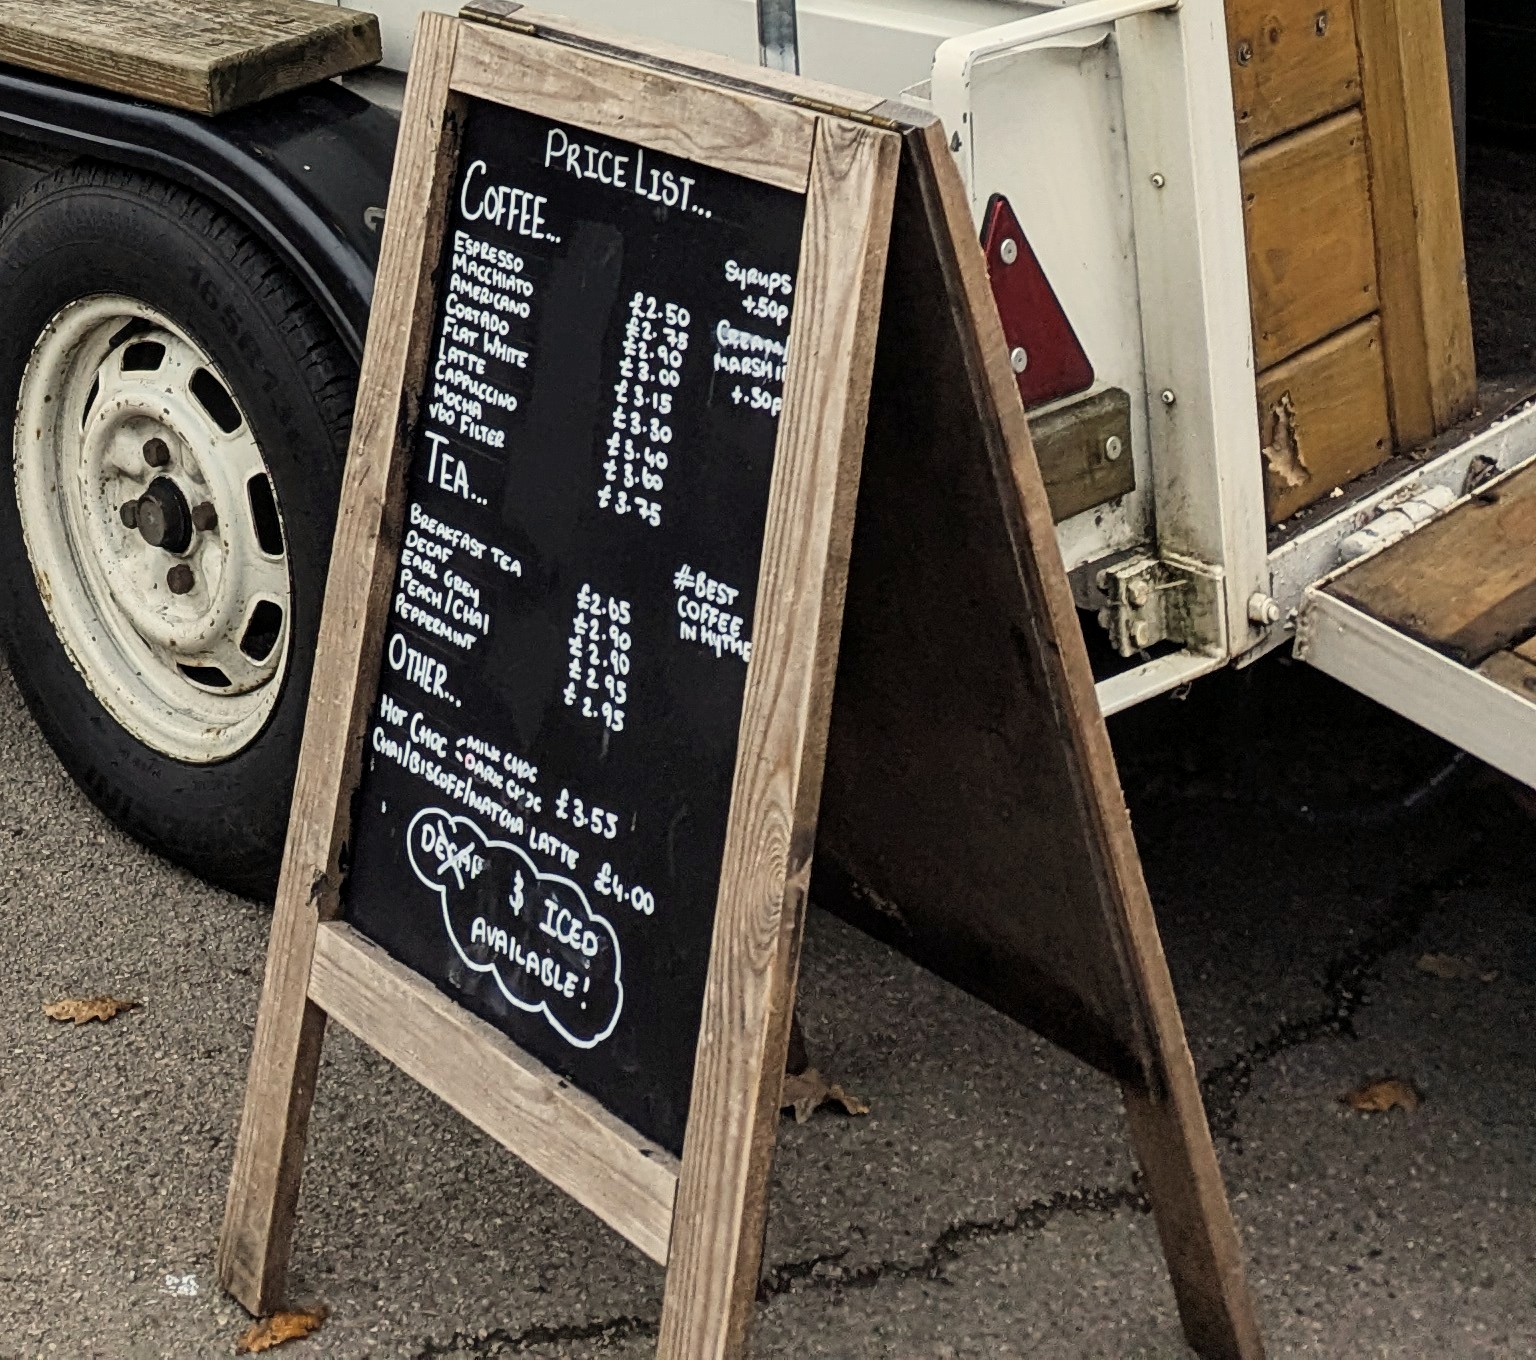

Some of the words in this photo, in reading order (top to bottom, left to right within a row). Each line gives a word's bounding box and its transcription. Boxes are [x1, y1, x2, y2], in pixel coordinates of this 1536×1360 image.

[544, 127, 629, 188] PRICE
[460, 159, 561, 244] COFFEE...
[452, 252, 534, 297] MACCHIATO
[454, 229, 524, 273] ESPRESSO
[445, 292, 510, 336] CORTADO
[450, 272, 531, 319] AMERICANO
[628, 291, 691, 328] £2.50
[438, 336, 487, 375] LATTE
[442, 315, 480, 347] FLAT
[483, 331, 529, 368] WHITE
[433, 382, 482, 420] MOCHA
[434, 359, 518, 412] CAPPUCCINO
[459, 414, 505, 448] FILTER
[424, 430, 488, 506] TEA...
[405, 529, 454, 563] DECAF
[410, 502, 488, 560] BREAKFAST
[490, 546, 522, 578] TEA
[400, 548, 438, 579] EARL
[443, 570, 480, 608] GREY
[672, 563, 740, 606] #BEST
[395, 592, 477, 650] PEPPERMINT
[576, 583, 631, 625] £2.65
[677, 595, 744, 639] COFFEE
[679, 621, 697, 641] IN
[700, 624, 753, 663] HYTHE
[388, 633, 462, 708] OTHER...
[380, 693, 409, 727] HOT
[410, 712, 448, 758] CHOC
[464, 752, 504, 790] DARK
[466, 735, 501, 763] MILK
[503, 752, 538, 783] CHOC
[529, 826, 580, 870] LATTE
[594, 862, 655, 916] £4.00
[538, 897, 599, 957] ICED
